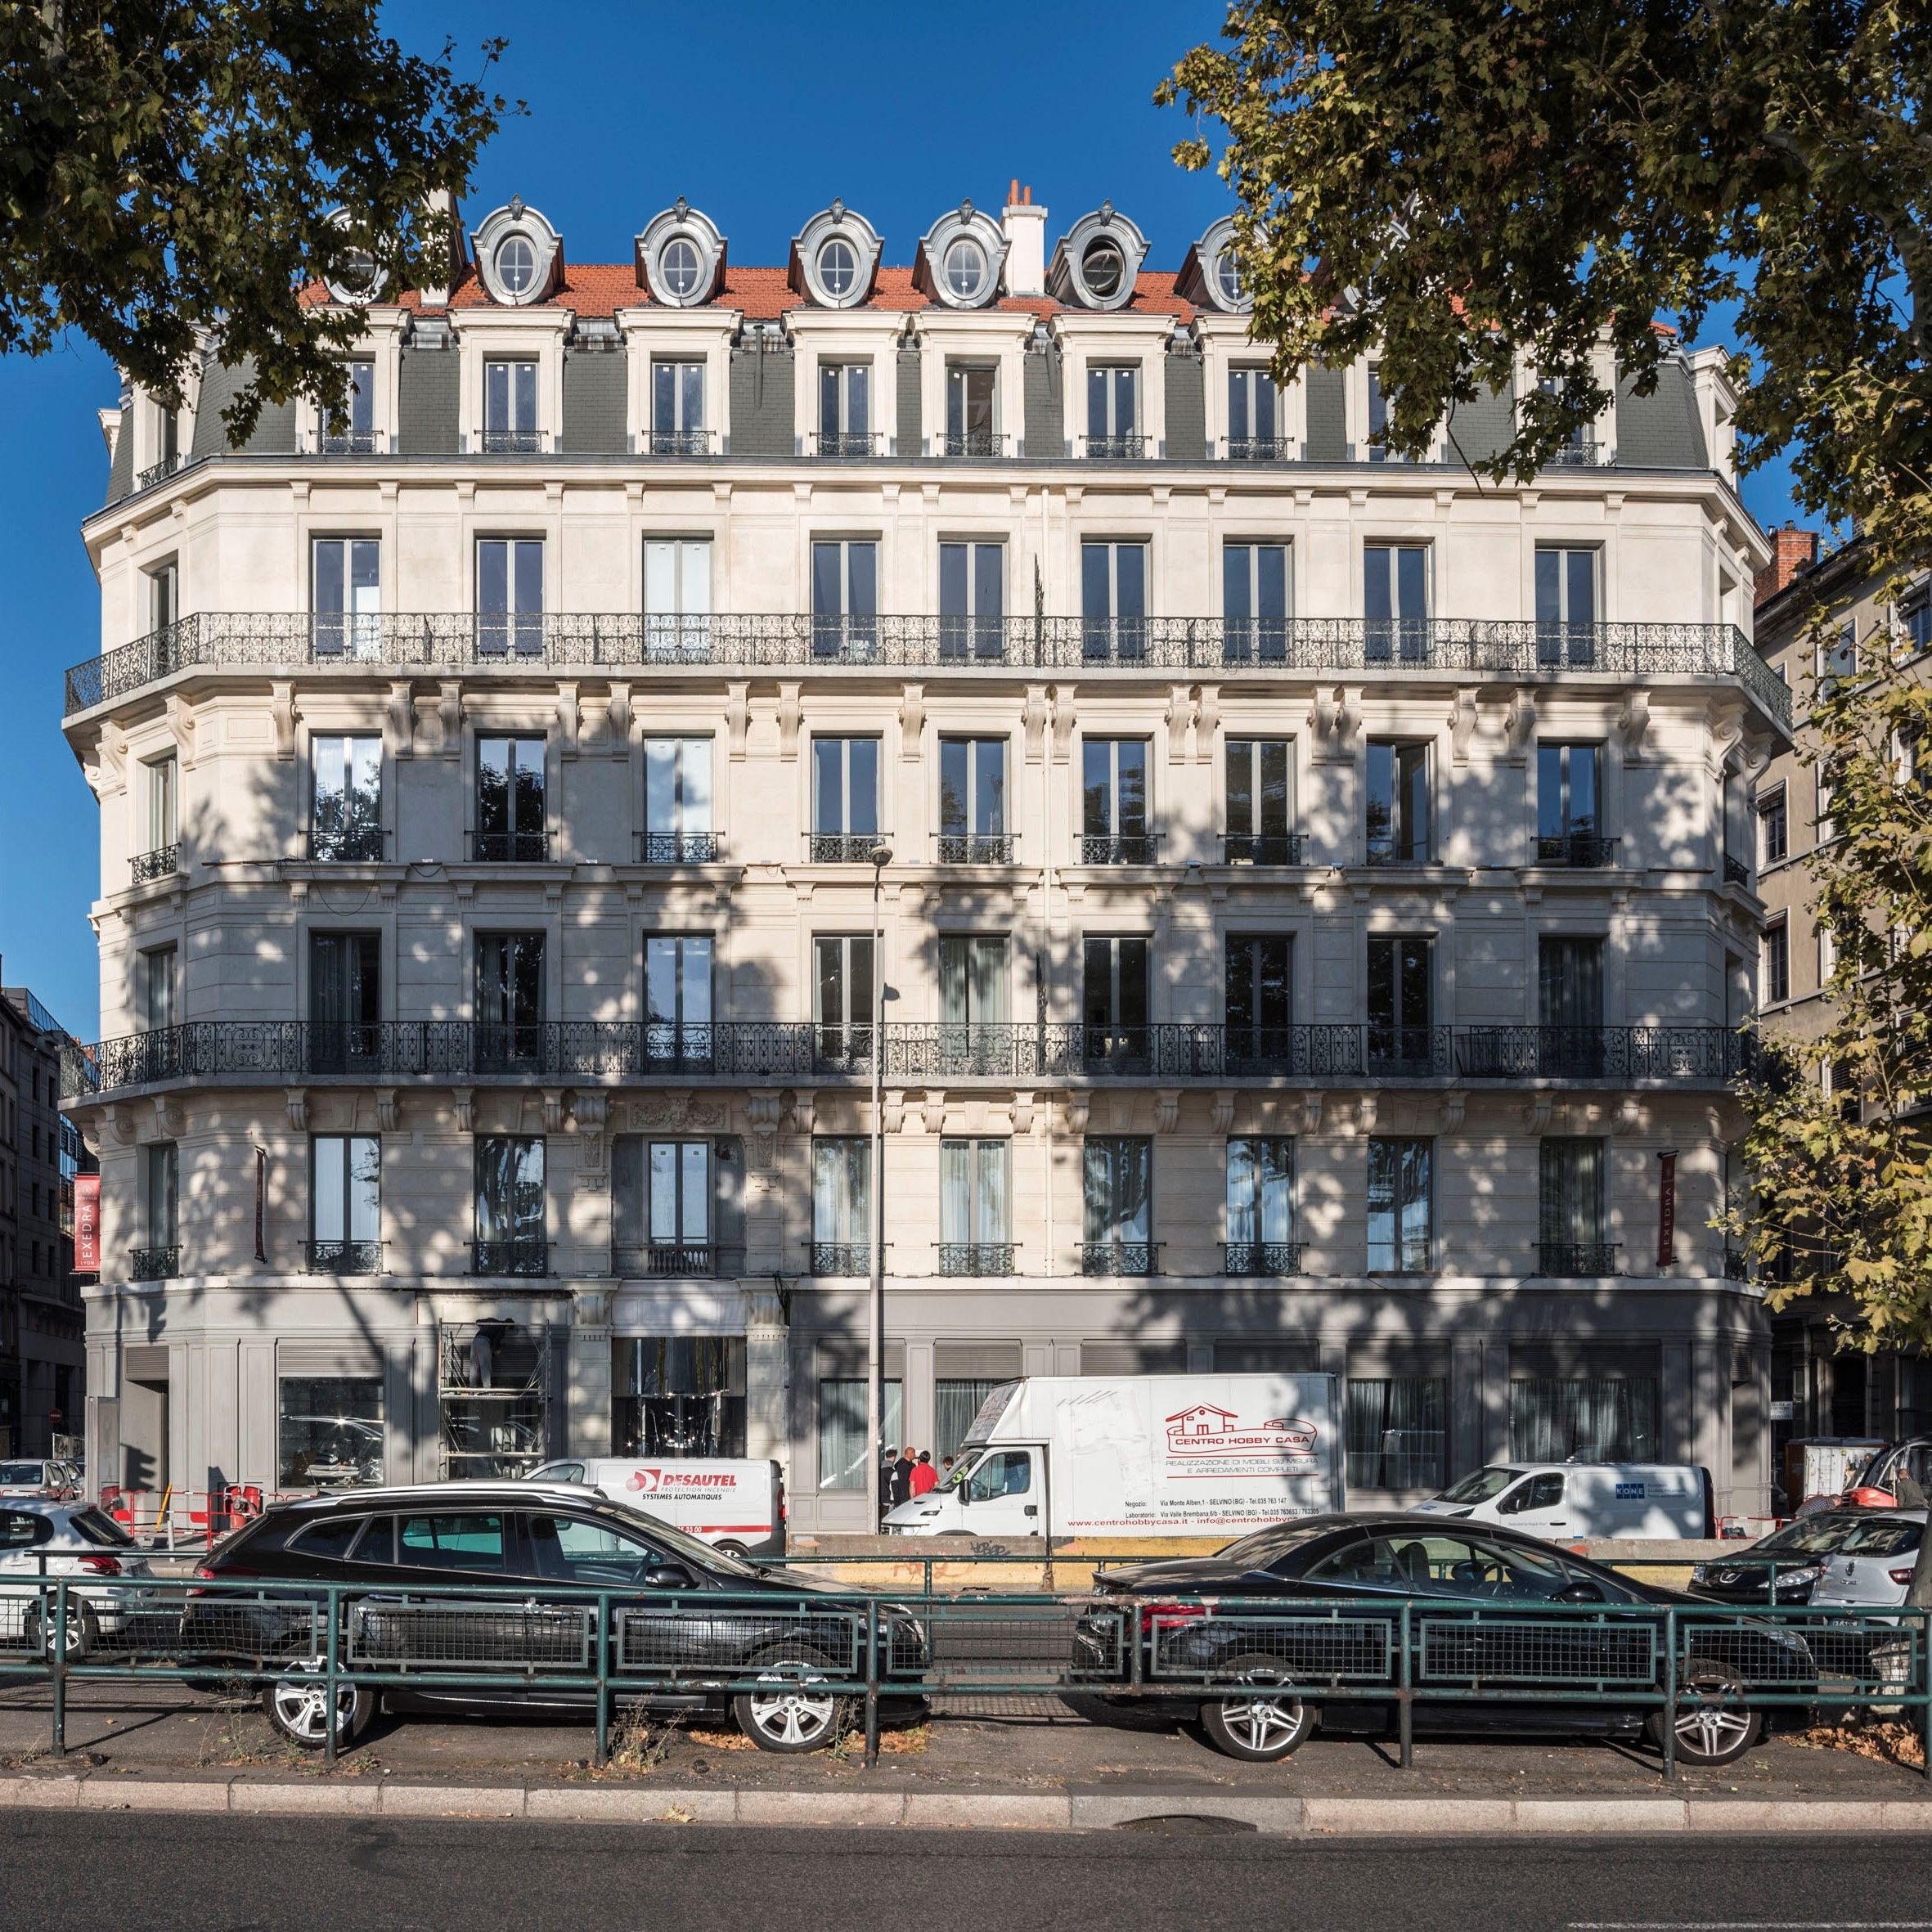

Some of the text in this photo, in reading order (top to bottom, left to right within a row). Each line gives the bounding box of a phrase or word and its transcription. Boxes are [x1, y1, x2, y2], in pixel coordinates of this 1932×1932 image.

[82, 1204, 92, 1258] EXEDRA
[663, 1474, 737, 1486] DESAUTEL
[1233, 1498, 1245, 1506] (BG)
[1245, 1508, 1258, 1516] (BG)
[1067, 1518, 1188, 1526] www.centrohobbycasa.it
